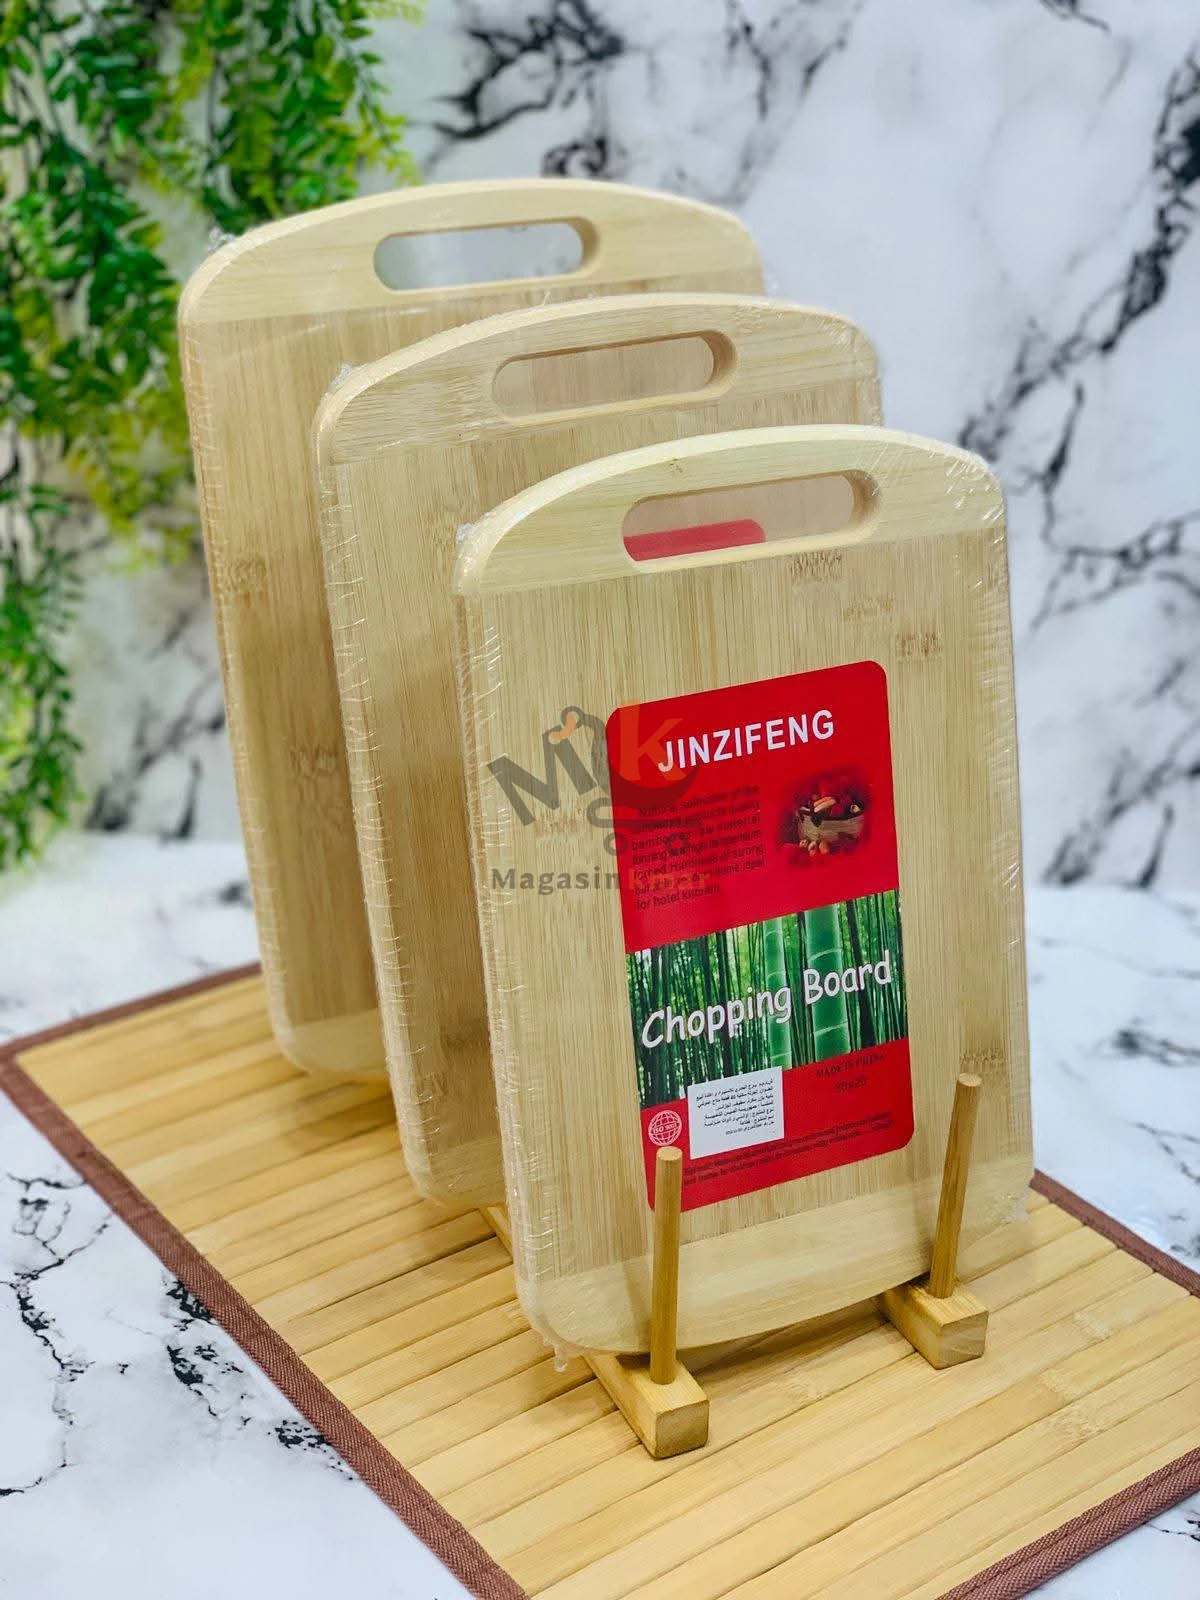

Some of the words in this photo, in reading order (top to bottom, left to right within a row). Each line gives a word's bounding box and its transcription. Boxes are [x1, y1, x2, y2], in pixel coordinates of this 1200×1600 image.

[658, 709, 835, 772] JINZIFENG
[641, 987, 792, 1048] Chopping
[803, 949, 892, 1006] Board
